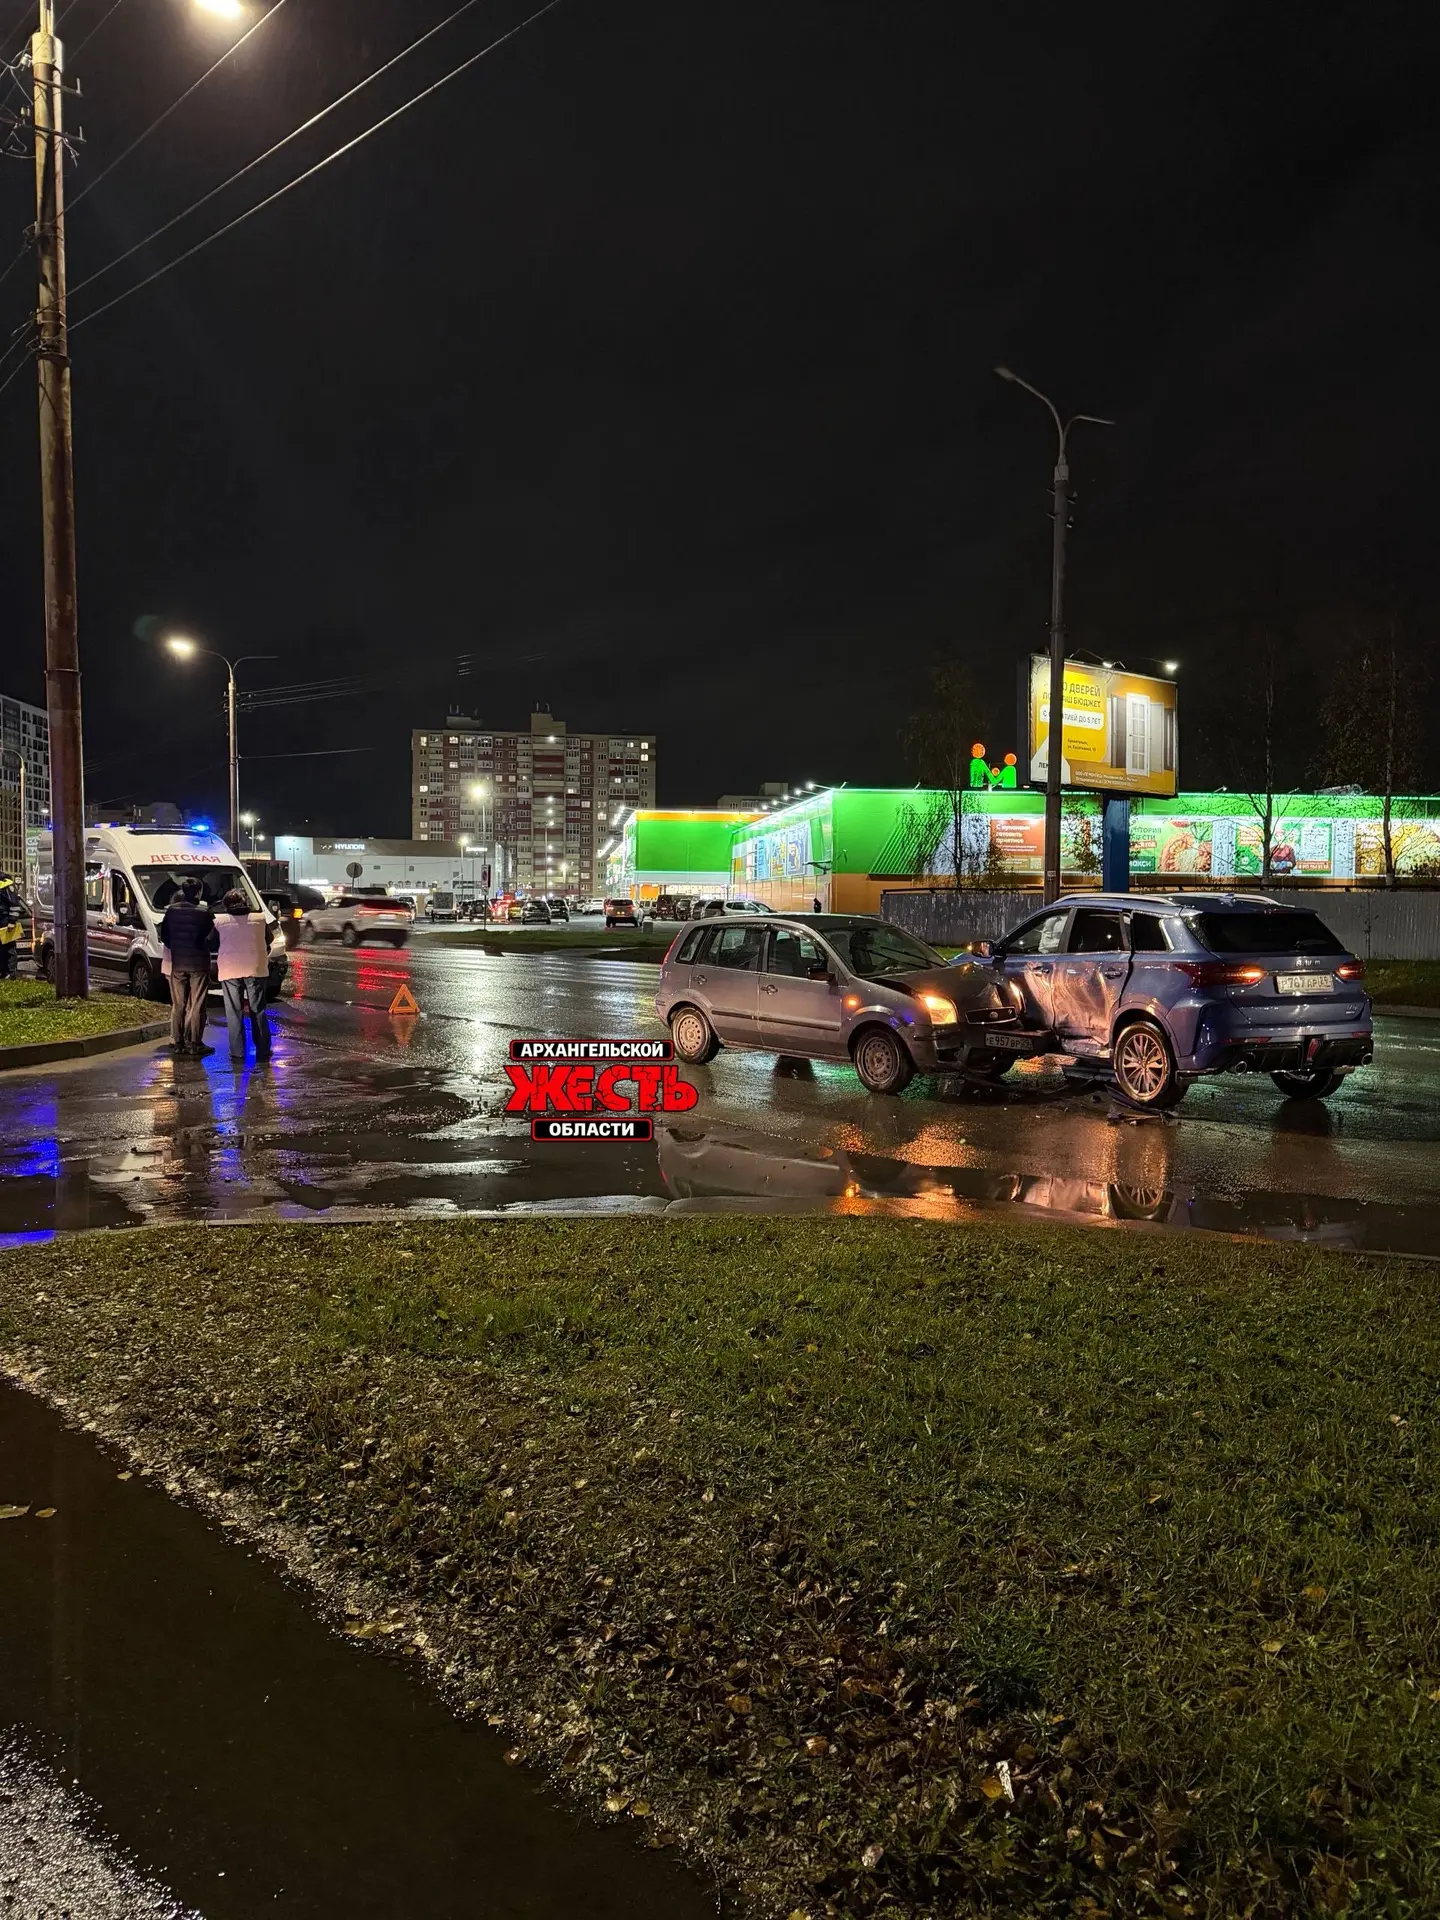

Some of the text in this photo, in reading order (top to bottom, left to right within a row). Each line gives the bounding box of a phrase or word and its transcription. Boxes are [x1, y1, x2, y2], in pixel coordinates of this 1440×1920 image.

[1069, 683, 1101, 697] ДВЕРЕЙ
[1073, 697, 1101, 708] БЮДЖЕТ
[150, 854, 221, 863] ДЕТСКАЯ
